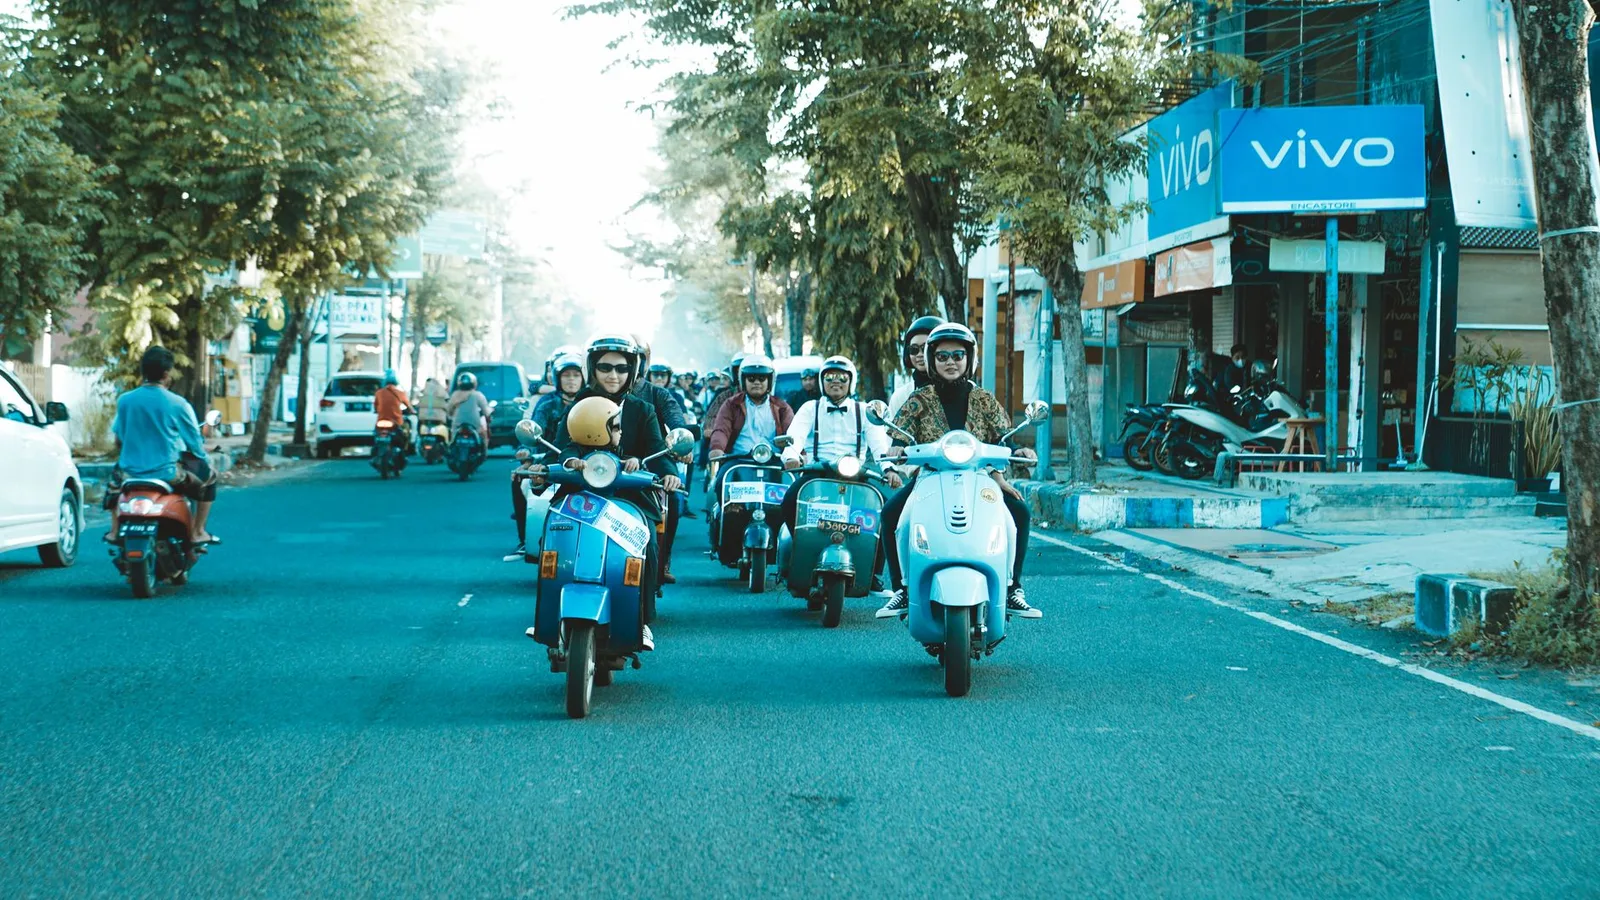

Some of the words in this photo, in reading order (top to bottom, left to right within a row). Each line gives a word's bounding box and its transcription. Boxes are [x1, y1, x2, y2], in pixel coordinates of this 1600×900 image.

[1251, 129, 1394, 169] vivo
[1160, 124, 1213, 199] vivo
[1291, 202, 1357, 210] ENCASTORE
[1295, 246, 1358, 264] ROOT
[818, 521, 825, 530] M
[826, 521, 848, 532] 3819
[848, 525, 861, 535] GH
